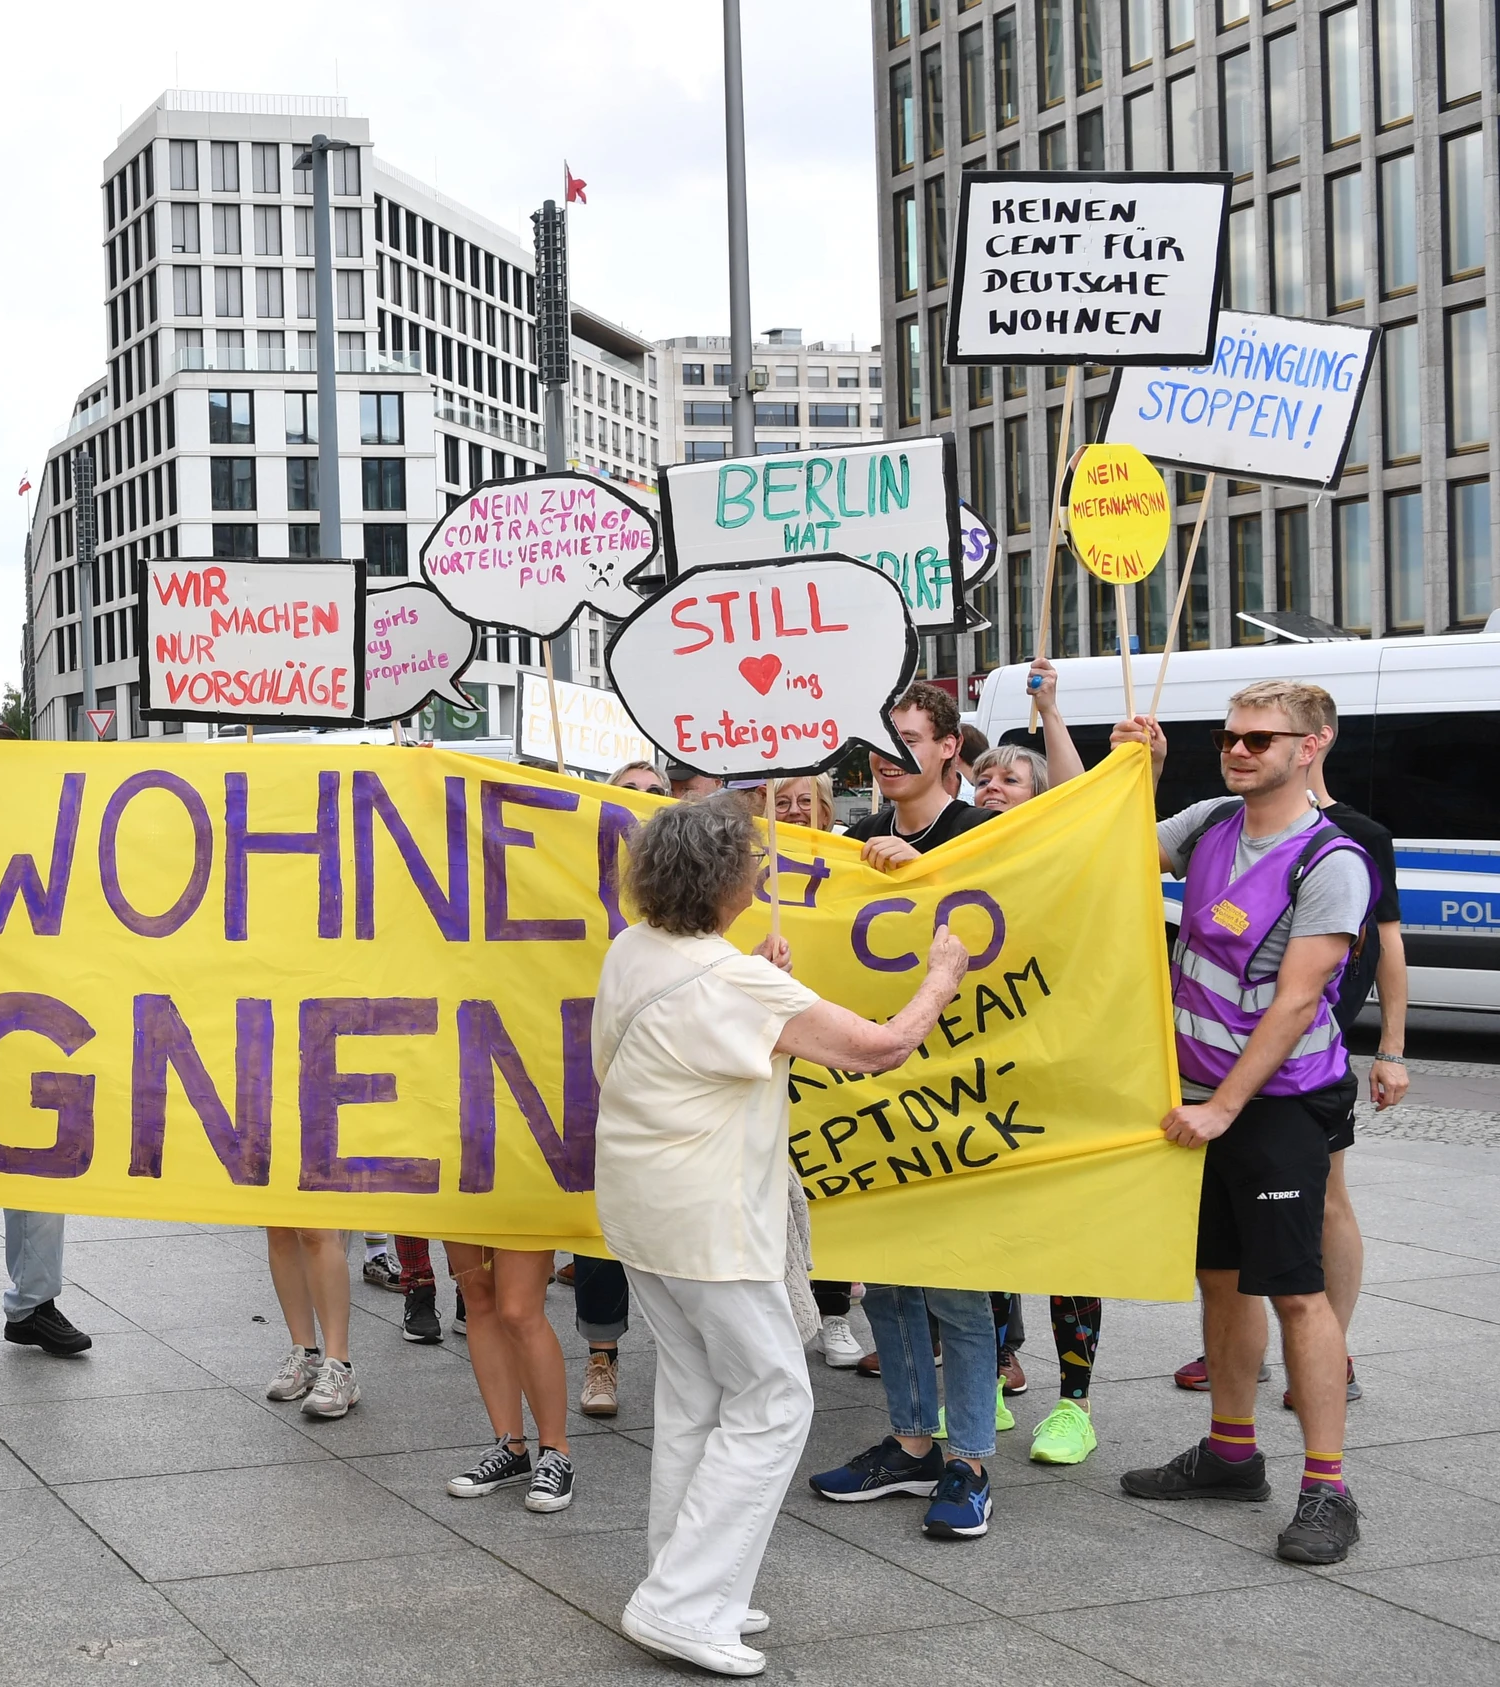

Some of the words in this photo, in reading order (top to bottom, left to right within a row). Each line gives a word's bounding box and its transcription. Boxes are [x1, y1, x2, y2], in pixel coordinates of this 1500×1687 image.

[993, 198, 1138, 225] KEINEN
[985, 234, 1081, 258] CENT
[1103, 226, 1185, 261] FÜR
[979, 270, 1171, 296] DEUTSCHE
[989, 308, 1161, 335] WOHNEN
[1147, 328, 1359, 392] RÄNGUNG
[1139, 381, 1323, 449] STOPPEN!
[1087, 462, 1128, 485] NEIN
[470, 491, 528, 521] NEIN
[540, 488, 596, 515] ZUM
[714, 454, 910, 529] BERLIN
[1073, 491, 1166, 519] MIETENWAHNSINN
[444, 508, 632, 547] CONTRACTING!
[784, 520, 841, 554] HAT
[428, 549, 513, 576] VORTEIL:
[518, 529, 651, 564] VERMIETENDE
[1088, 544, 1146, 578] NEIN!
[153, 566, 230, 608] WIR
[519, 564, 567, 589] PUR
[211, 601, 340, 639] MACHEN
[373, 605, 419, 637] girls
[670, 582, 849, 656] STILL
[156, 631, 215, 664] NUR
[366, 639, 393, 660] ay
[165, 660, 349, 709] VORSCHLÄGE
[785, 669, 823, 699] ing
[674, 709, 839, 760] Enteignug
[1441, 900, 1500, 923] POL
[851, 889, 1006, 972] CO
[1267, 1190, 1300, 1200] TERREX
